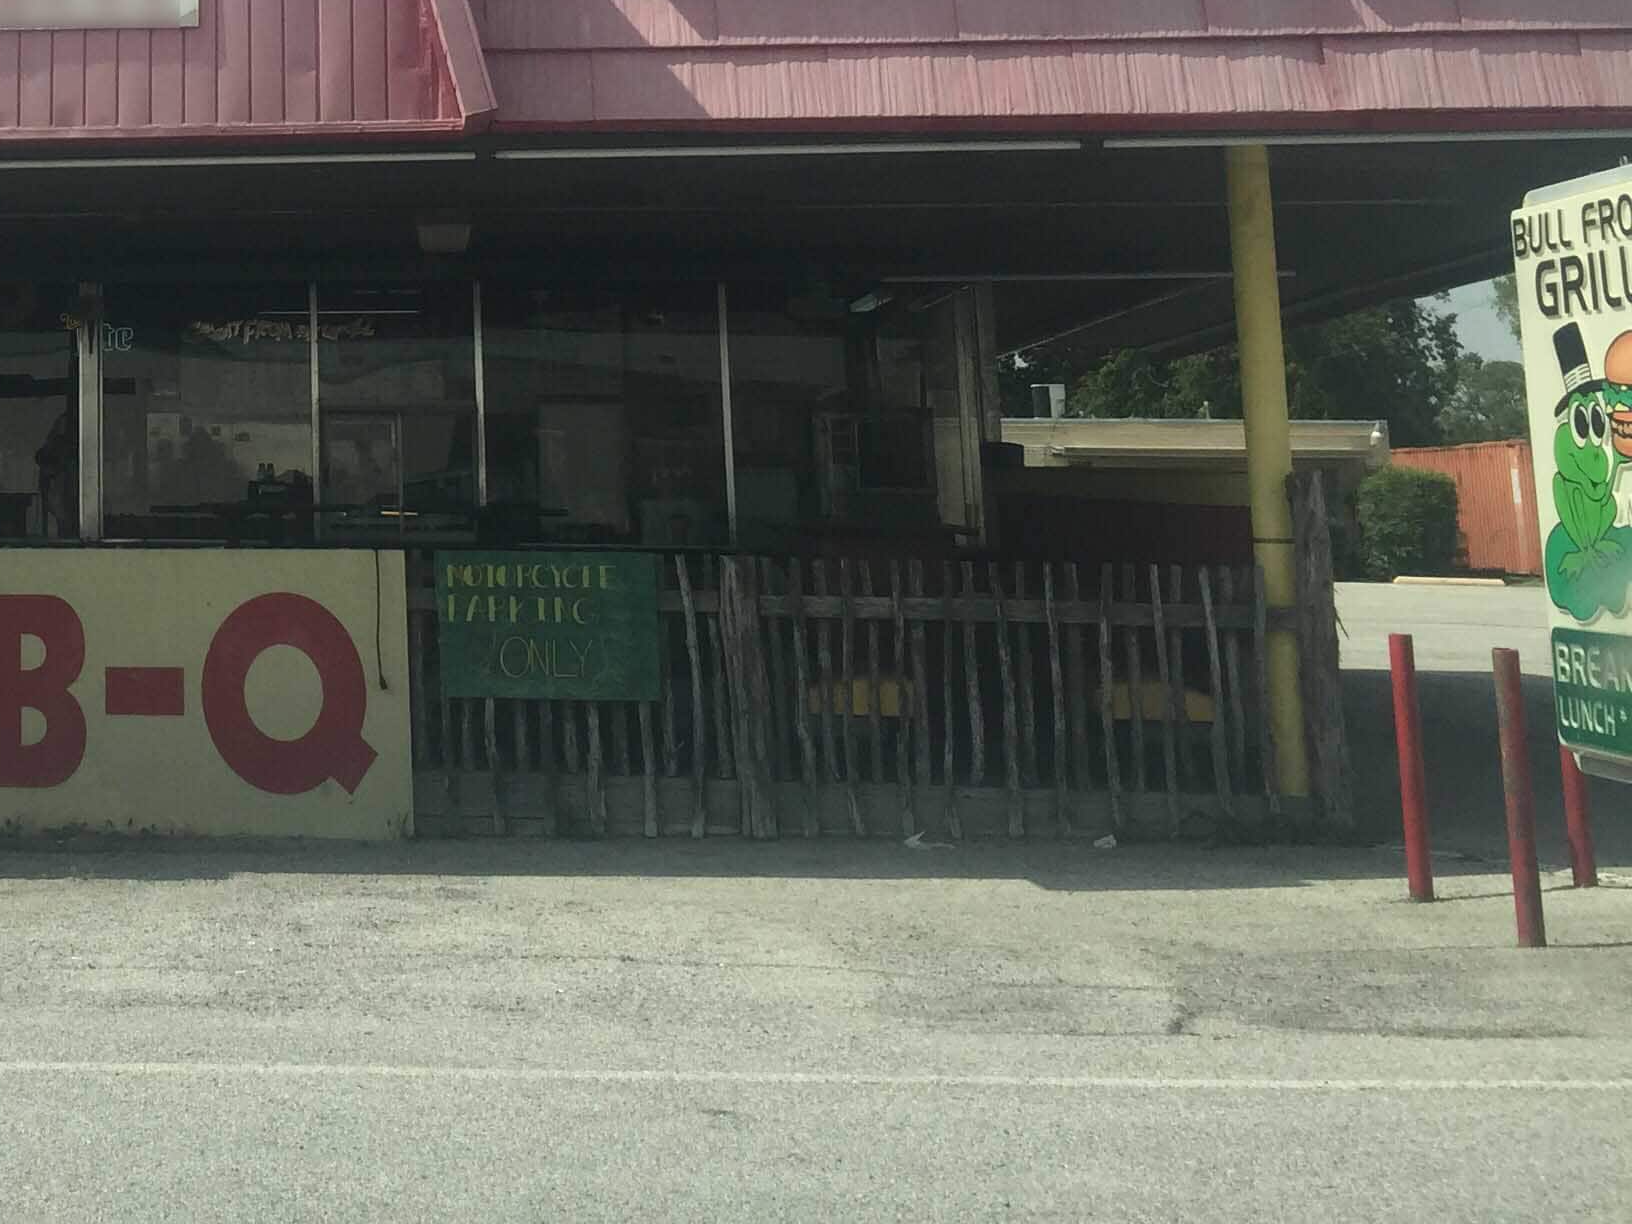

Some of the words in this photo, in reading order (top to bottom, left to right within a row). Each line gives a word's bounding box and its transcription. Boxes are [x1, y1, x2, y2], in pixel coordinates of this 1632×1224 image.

[1512, 208, 1573, 259] BULL
[499, 636, 593, 678] ONLY
[1558, 696, 1617, 737] LUNCH
